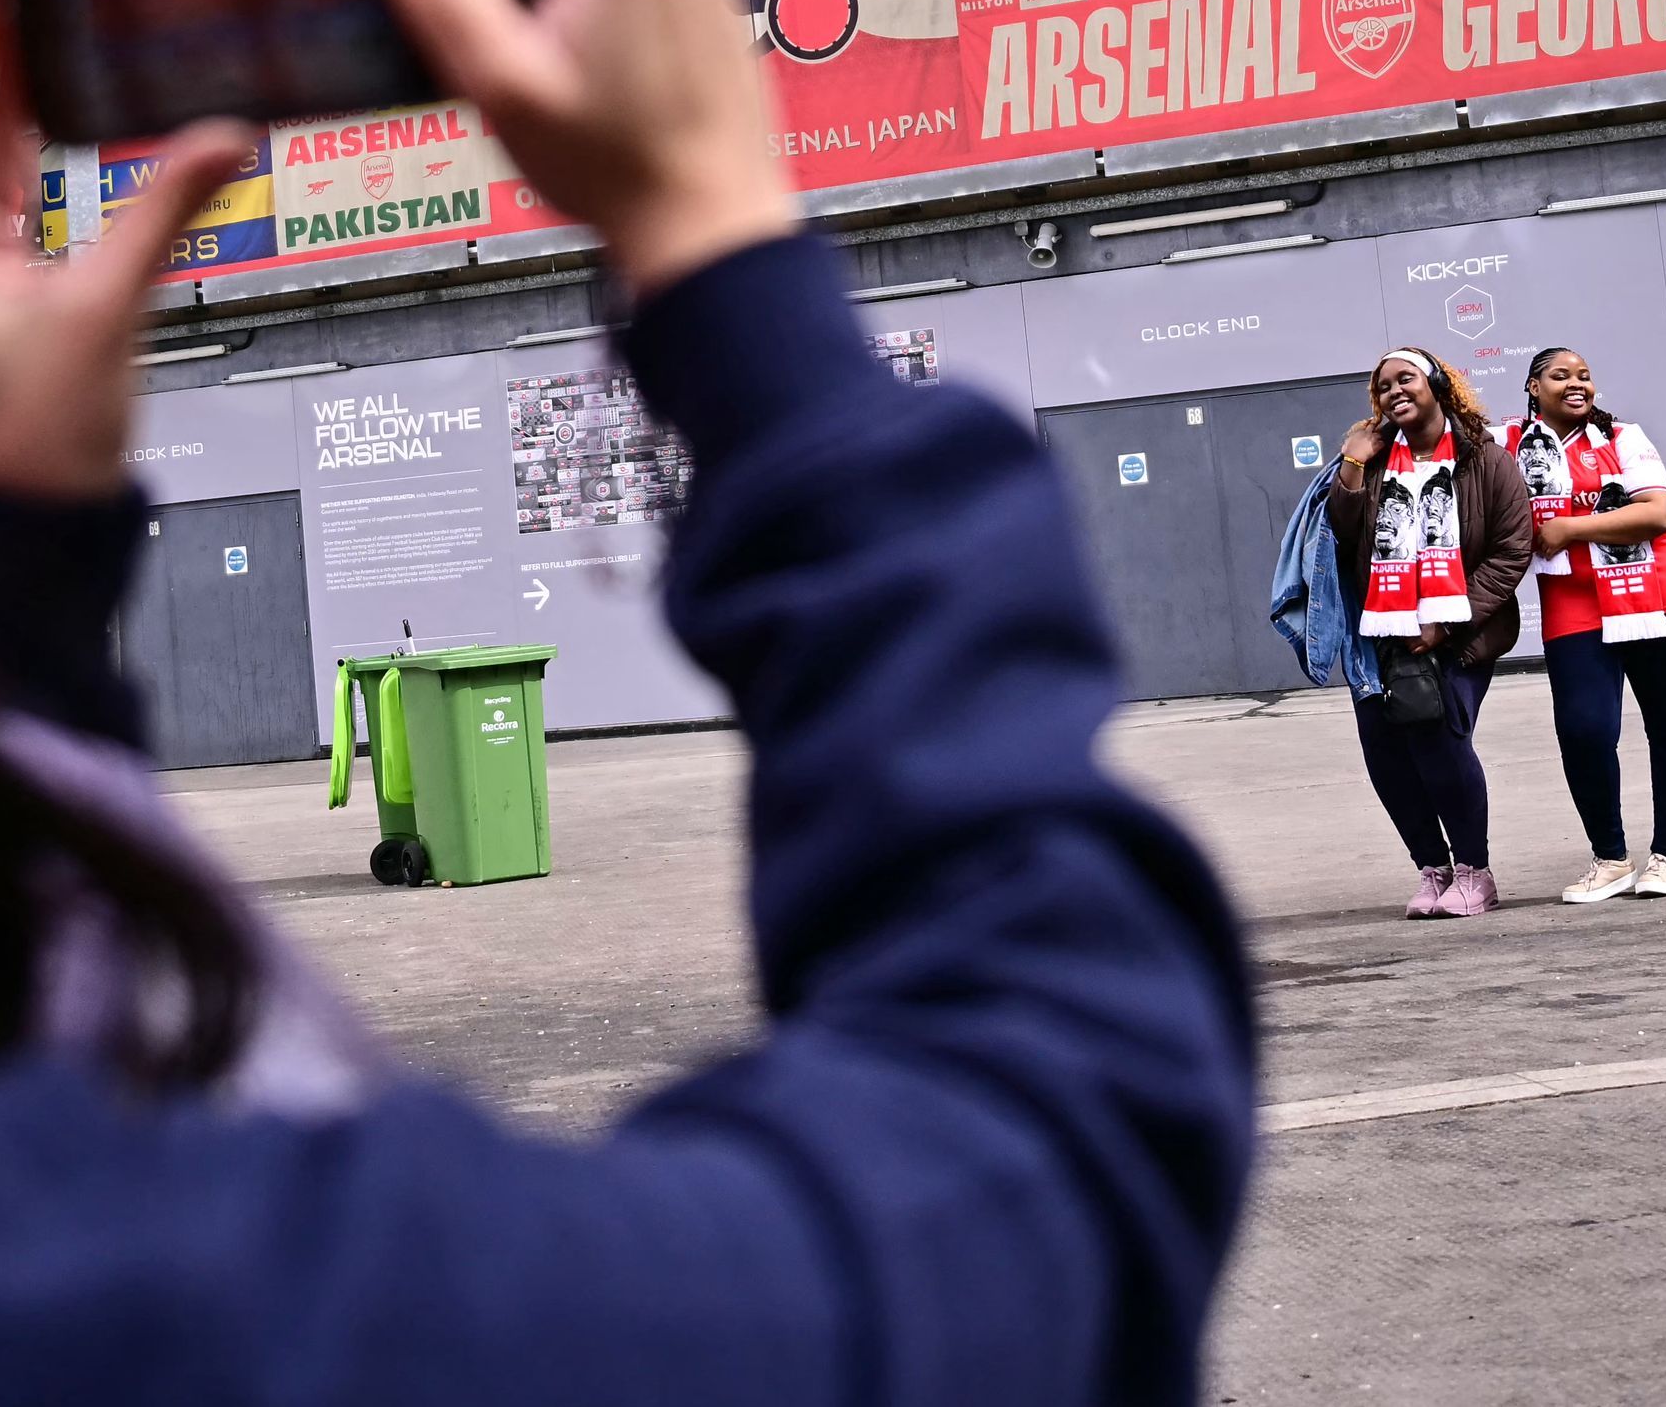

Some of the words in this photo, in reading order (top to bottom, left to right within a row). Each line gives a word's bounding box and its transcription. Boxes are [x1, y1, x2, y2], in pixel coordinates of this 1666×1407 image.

[285, 109, 469, 168] ARSENAL
[284, 188, 482, 248] PAKISTAN
[1407, 255, 1508, 282] KICK-OFF
[1456, 303, 1483, 314] 3PM
[1457, 313, 1484, 322] London
[1141, 321, 1210, 343] CLOCK
[1217, 314, 1261, 335] END
[1474, 347, 1501, 358] 3PM
[1472, 368, 1488, 376] New
[1489, 366, 1506, 374] York
[314, 398, 356, 423] WE
[361, 393, 408, 418] ALL
[1188, 408, 1201, 424] 68
[316, 414, 424, 446] FOLLOW
[428, 407, 482, 433] THE
[318, 437, 442, 470] ARSENAL
[1597, 564, 1651, 578] MADUEKE
[481, 720, 518, 732] Recorra
